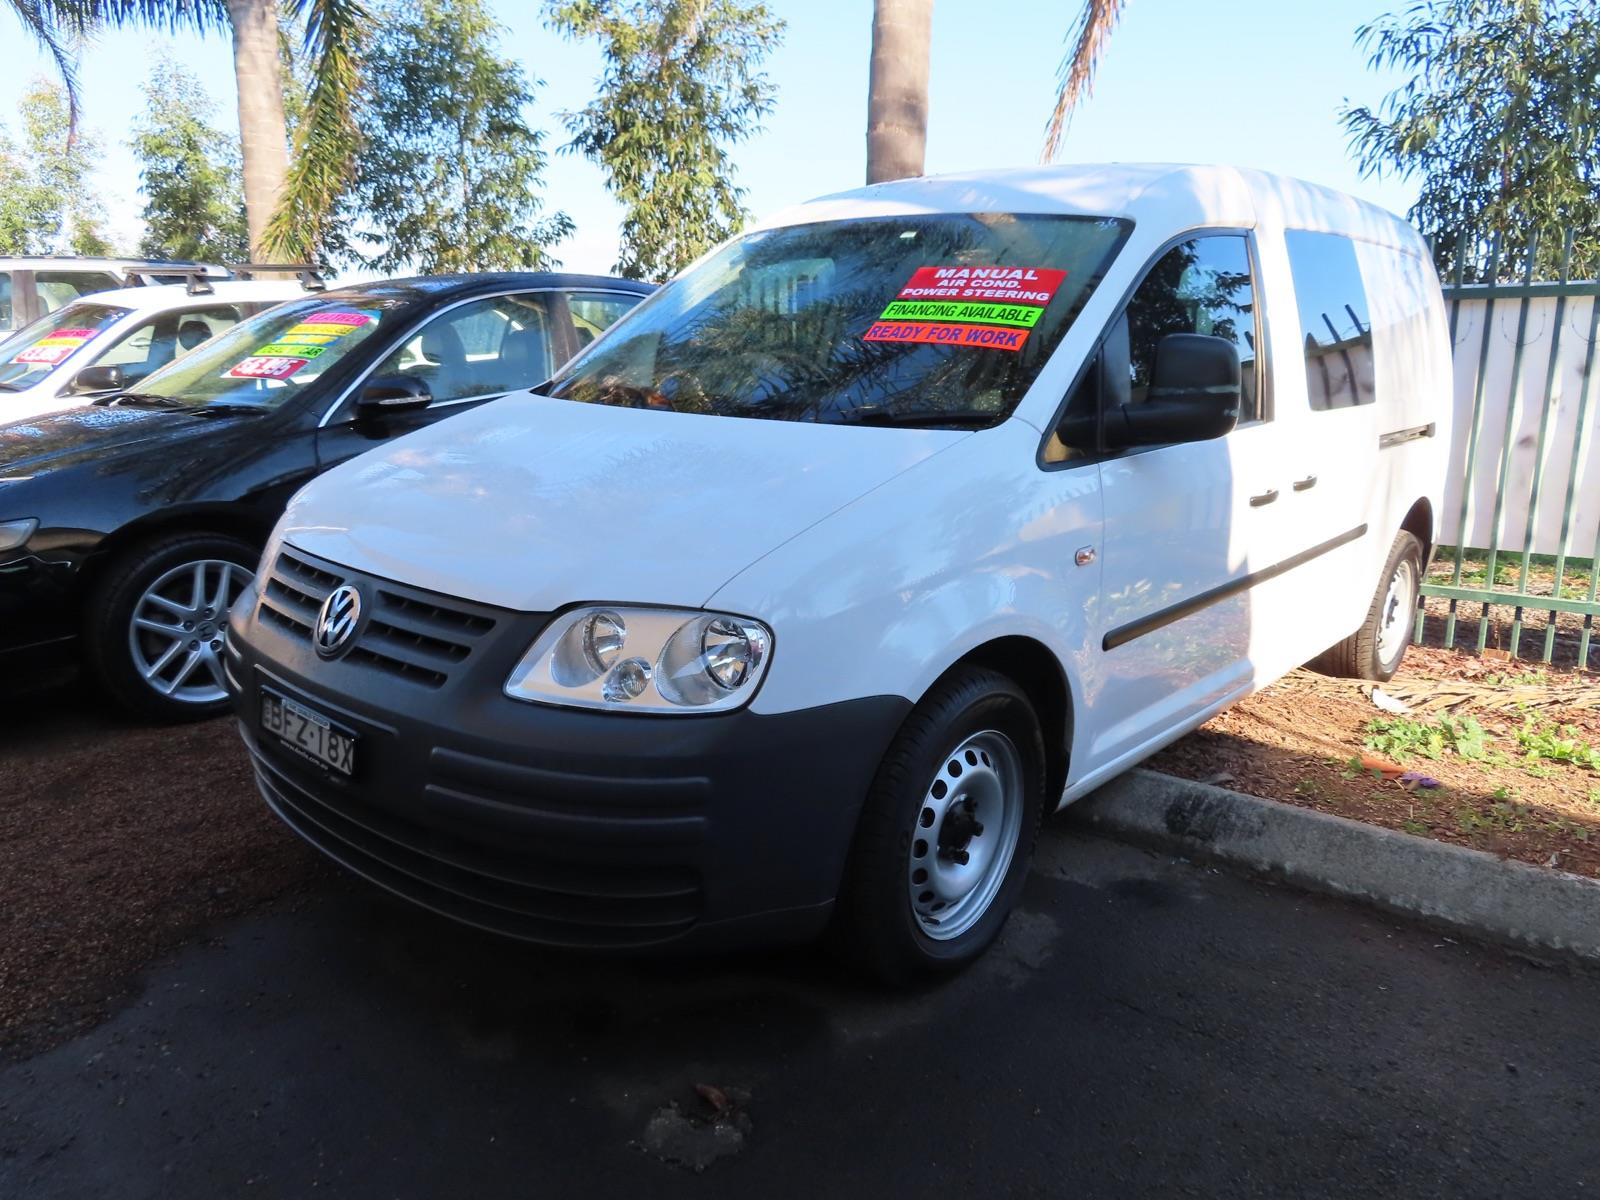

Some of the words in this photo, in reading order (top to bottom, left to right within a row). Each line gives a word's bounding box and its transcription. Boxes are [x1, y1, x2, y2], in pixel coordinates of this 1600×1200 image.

[934, 268, 1039, 281] MANUAL
[936, 279, 966, 288] AIR
[970, 279, 1021, 289] COND.
[901, 288, 959, 297] POWER
[962, 288, 1050, 301] STEERING
[886, 303, 958, 317] FINANCING
[958, 306, 1035, 323] AVAILABLE
[868, 325, 928, 339] READY
[927, 327, 964, 341] FOR
[965, 329, 1022, 347] WORK
